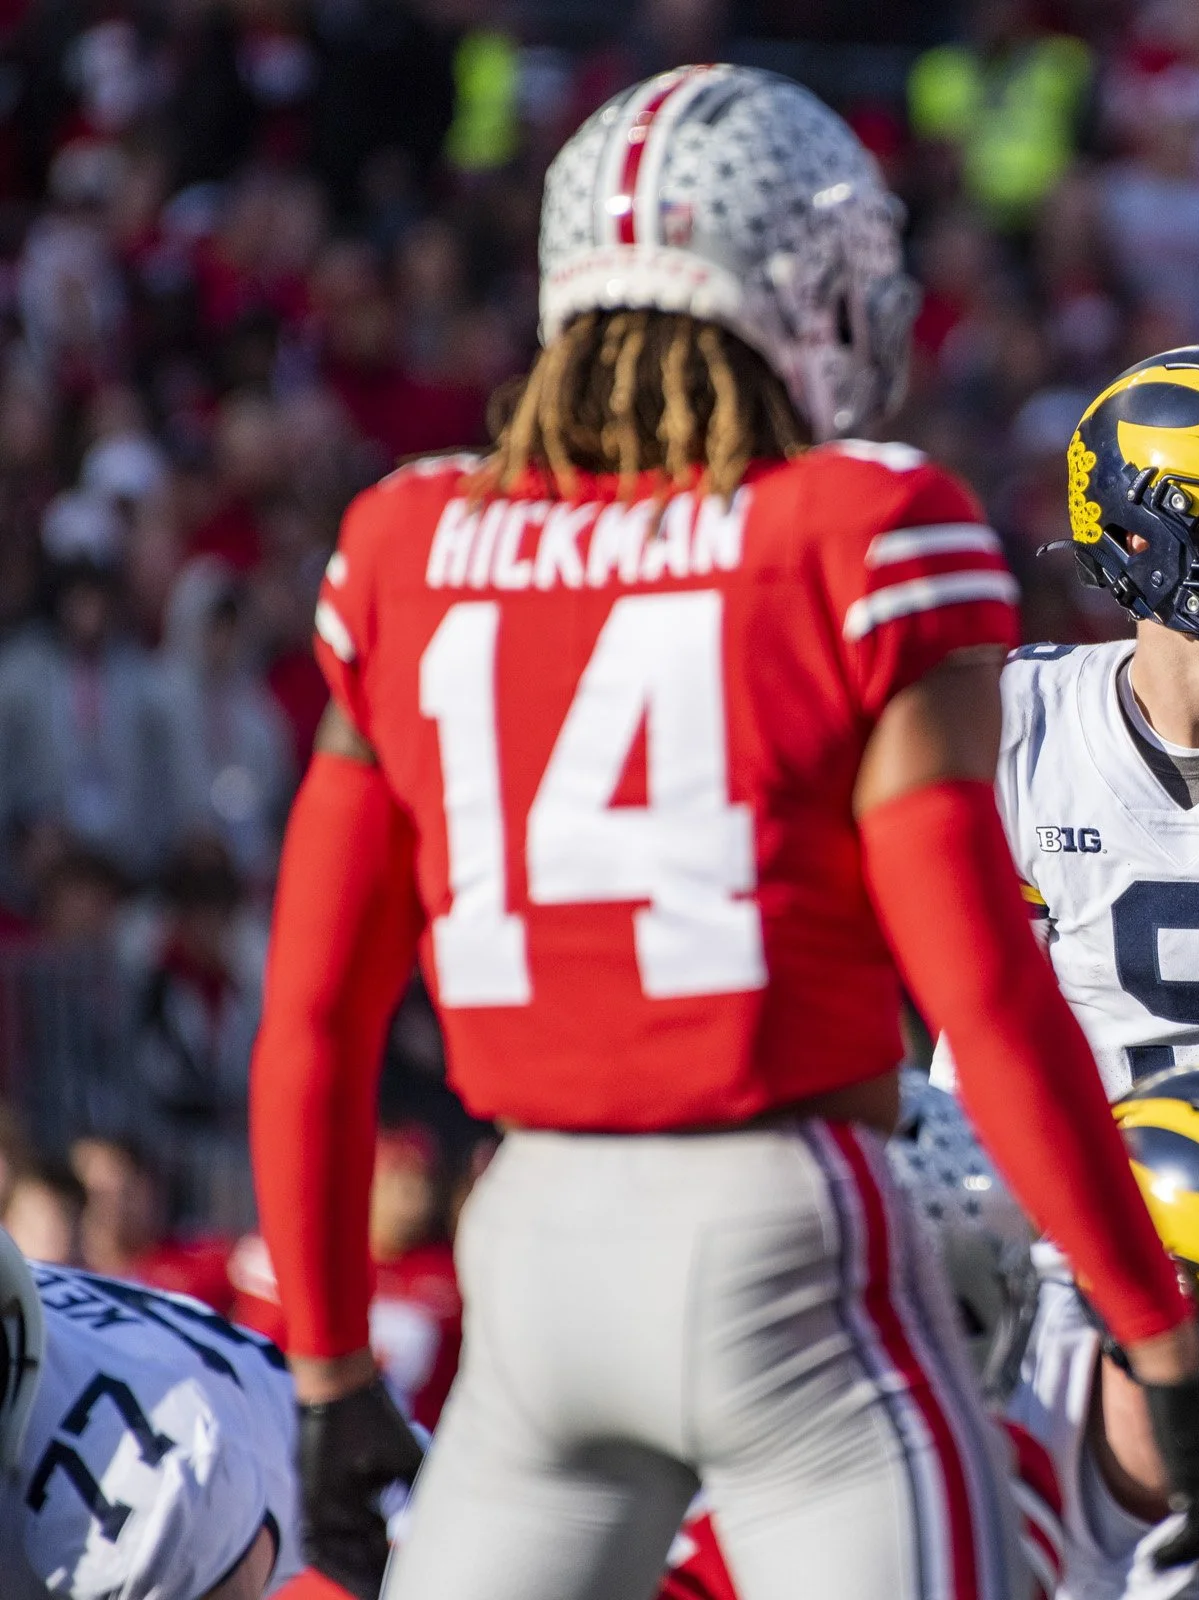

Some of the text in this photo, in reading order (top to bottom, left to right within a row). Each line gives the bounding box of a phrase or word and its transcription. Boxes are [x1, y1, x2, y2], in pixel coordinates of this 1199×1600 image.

[426, 484, 753, 591] HICKMAN
[419, 589, 769, 1008] 14
[26, 1371, 176, 1543] 77
